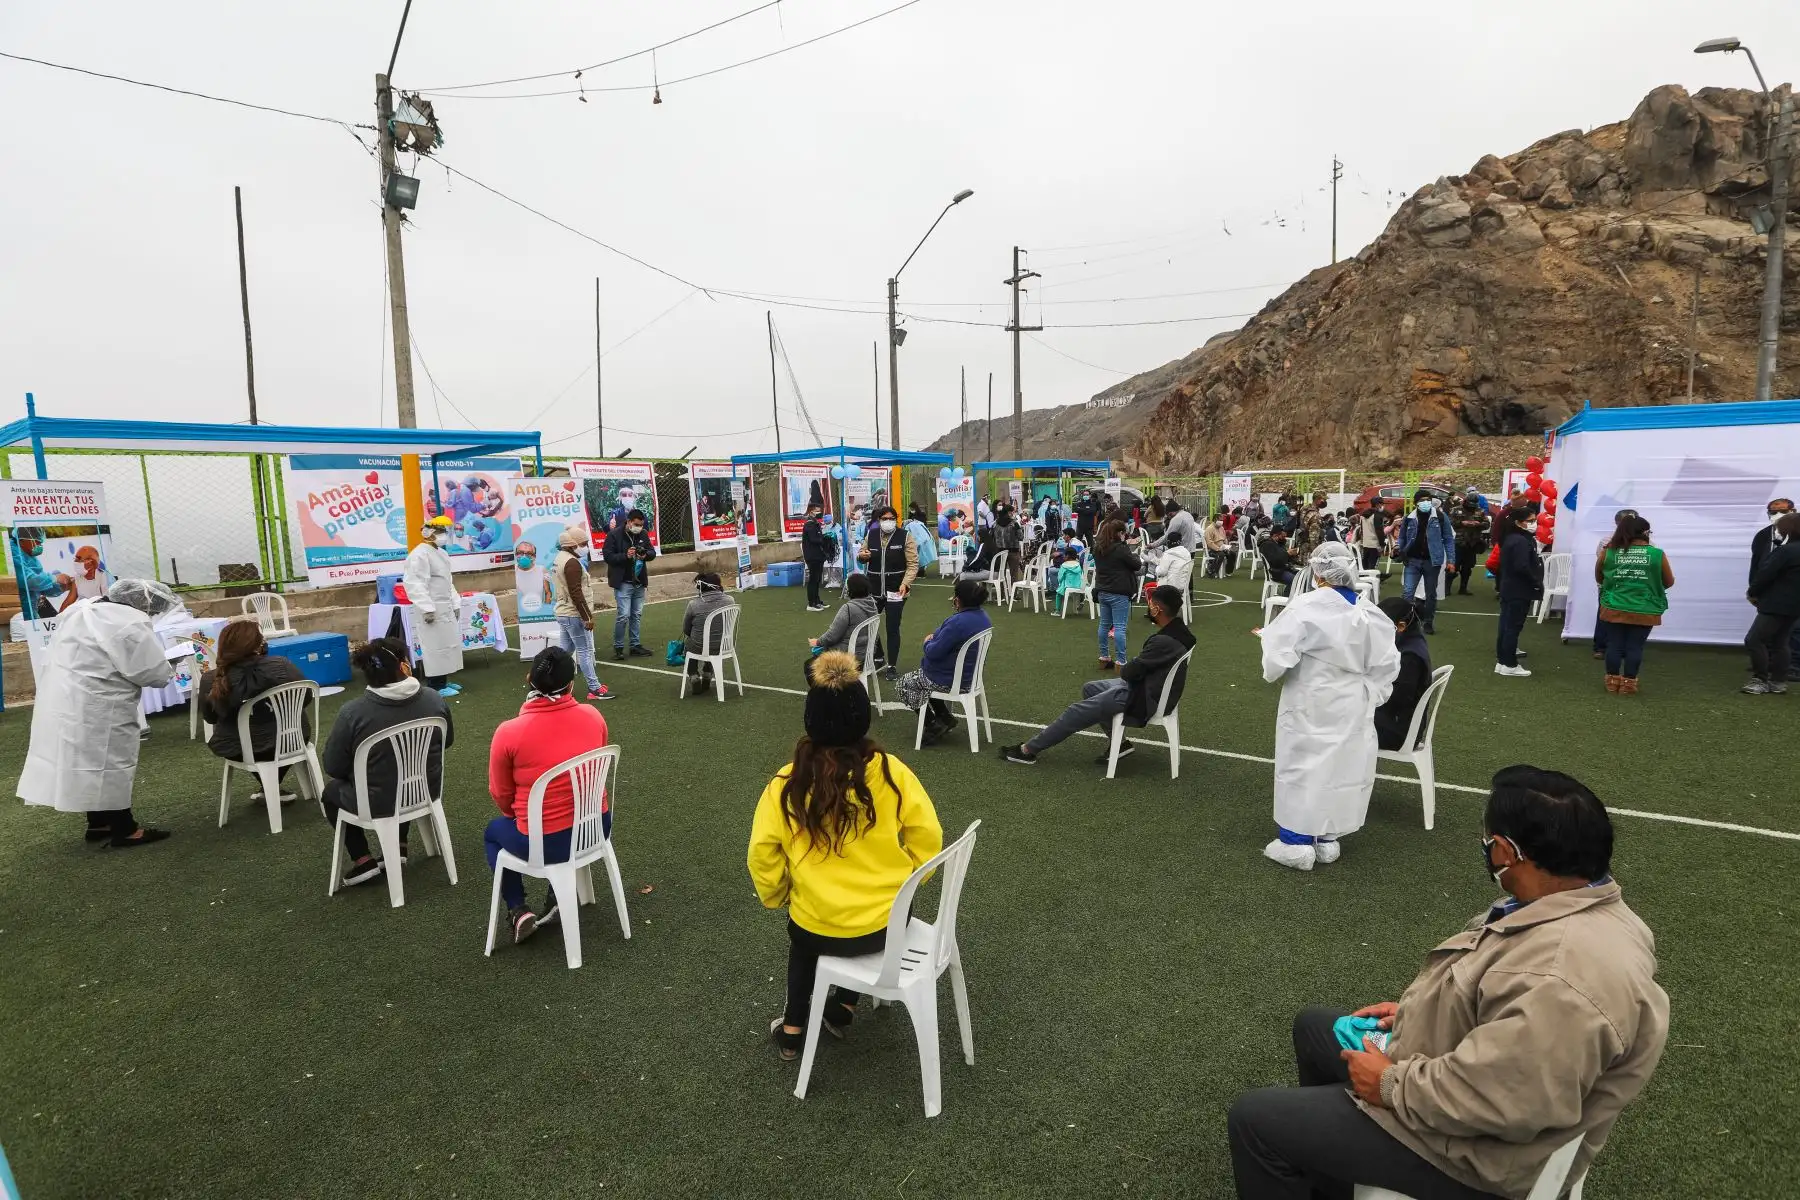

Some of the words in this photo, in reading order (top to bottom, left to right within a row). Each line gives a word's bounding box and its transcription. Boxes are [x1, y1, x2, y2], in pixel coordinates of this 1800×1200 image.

[359, 458, 401, 466] VACUNACIÓN
[37, 487, 54, 495] bajas
[16, 495, 71, 505] AUMENTA
[75, 495, 95, 505] TUS
[328, 486, 384, 518] confía
[526, 491, 575, 507] confía
[576, 494, 582, 503] y
[14, 505, 100, 515] PRECAUCIONES
[518, 504, 581, 522] protege
[323, 497, 394, 540] protege
